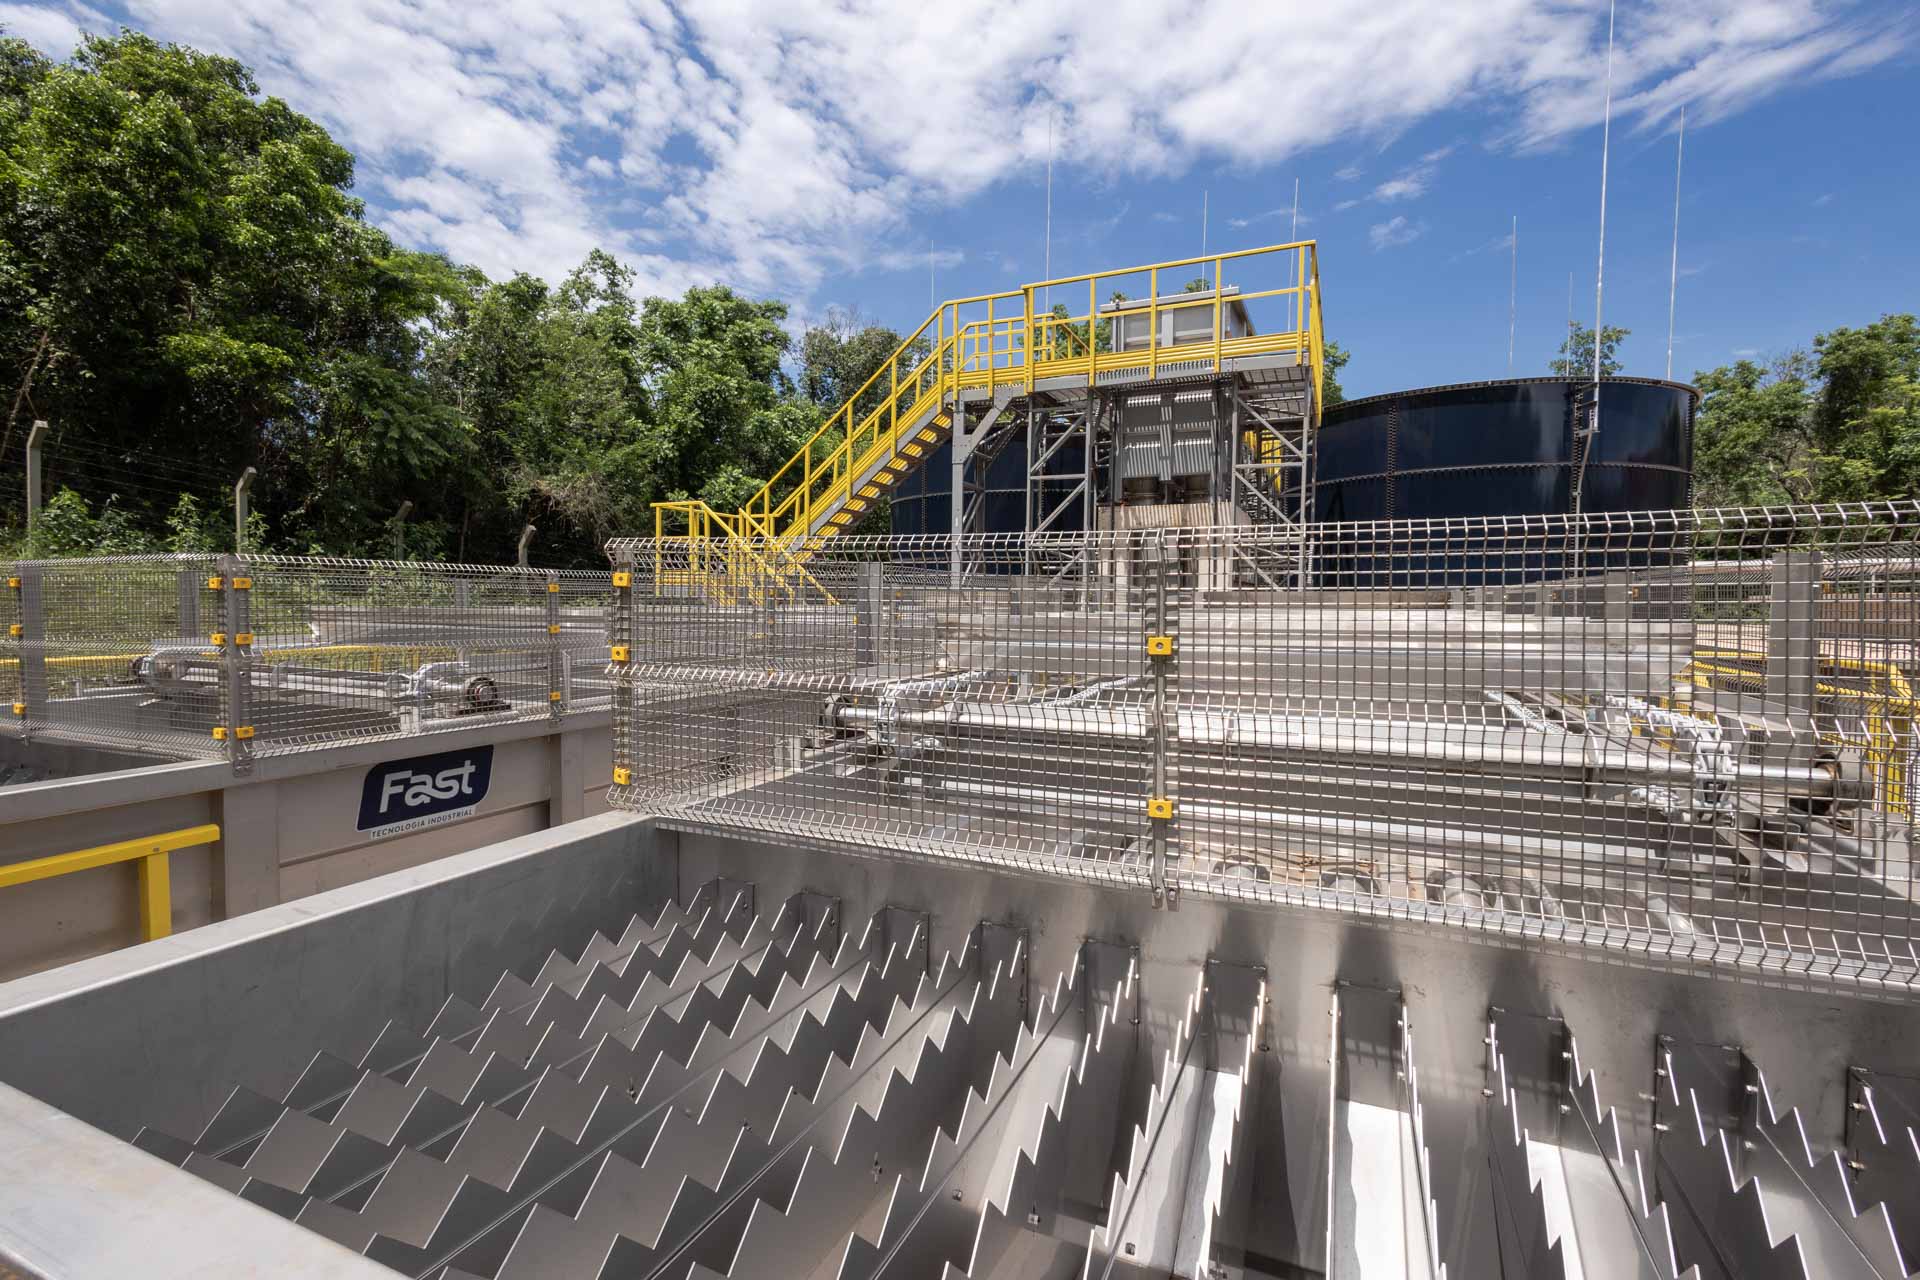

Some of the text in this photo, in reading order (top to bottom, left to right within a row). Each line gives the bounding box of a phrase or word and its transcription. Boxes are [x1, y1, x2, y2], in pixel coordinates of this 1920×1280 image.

[379, 760, 476, 813] Fast
[372, 810, 472, 838] TECNOLOGIA INDUSTRIAL
